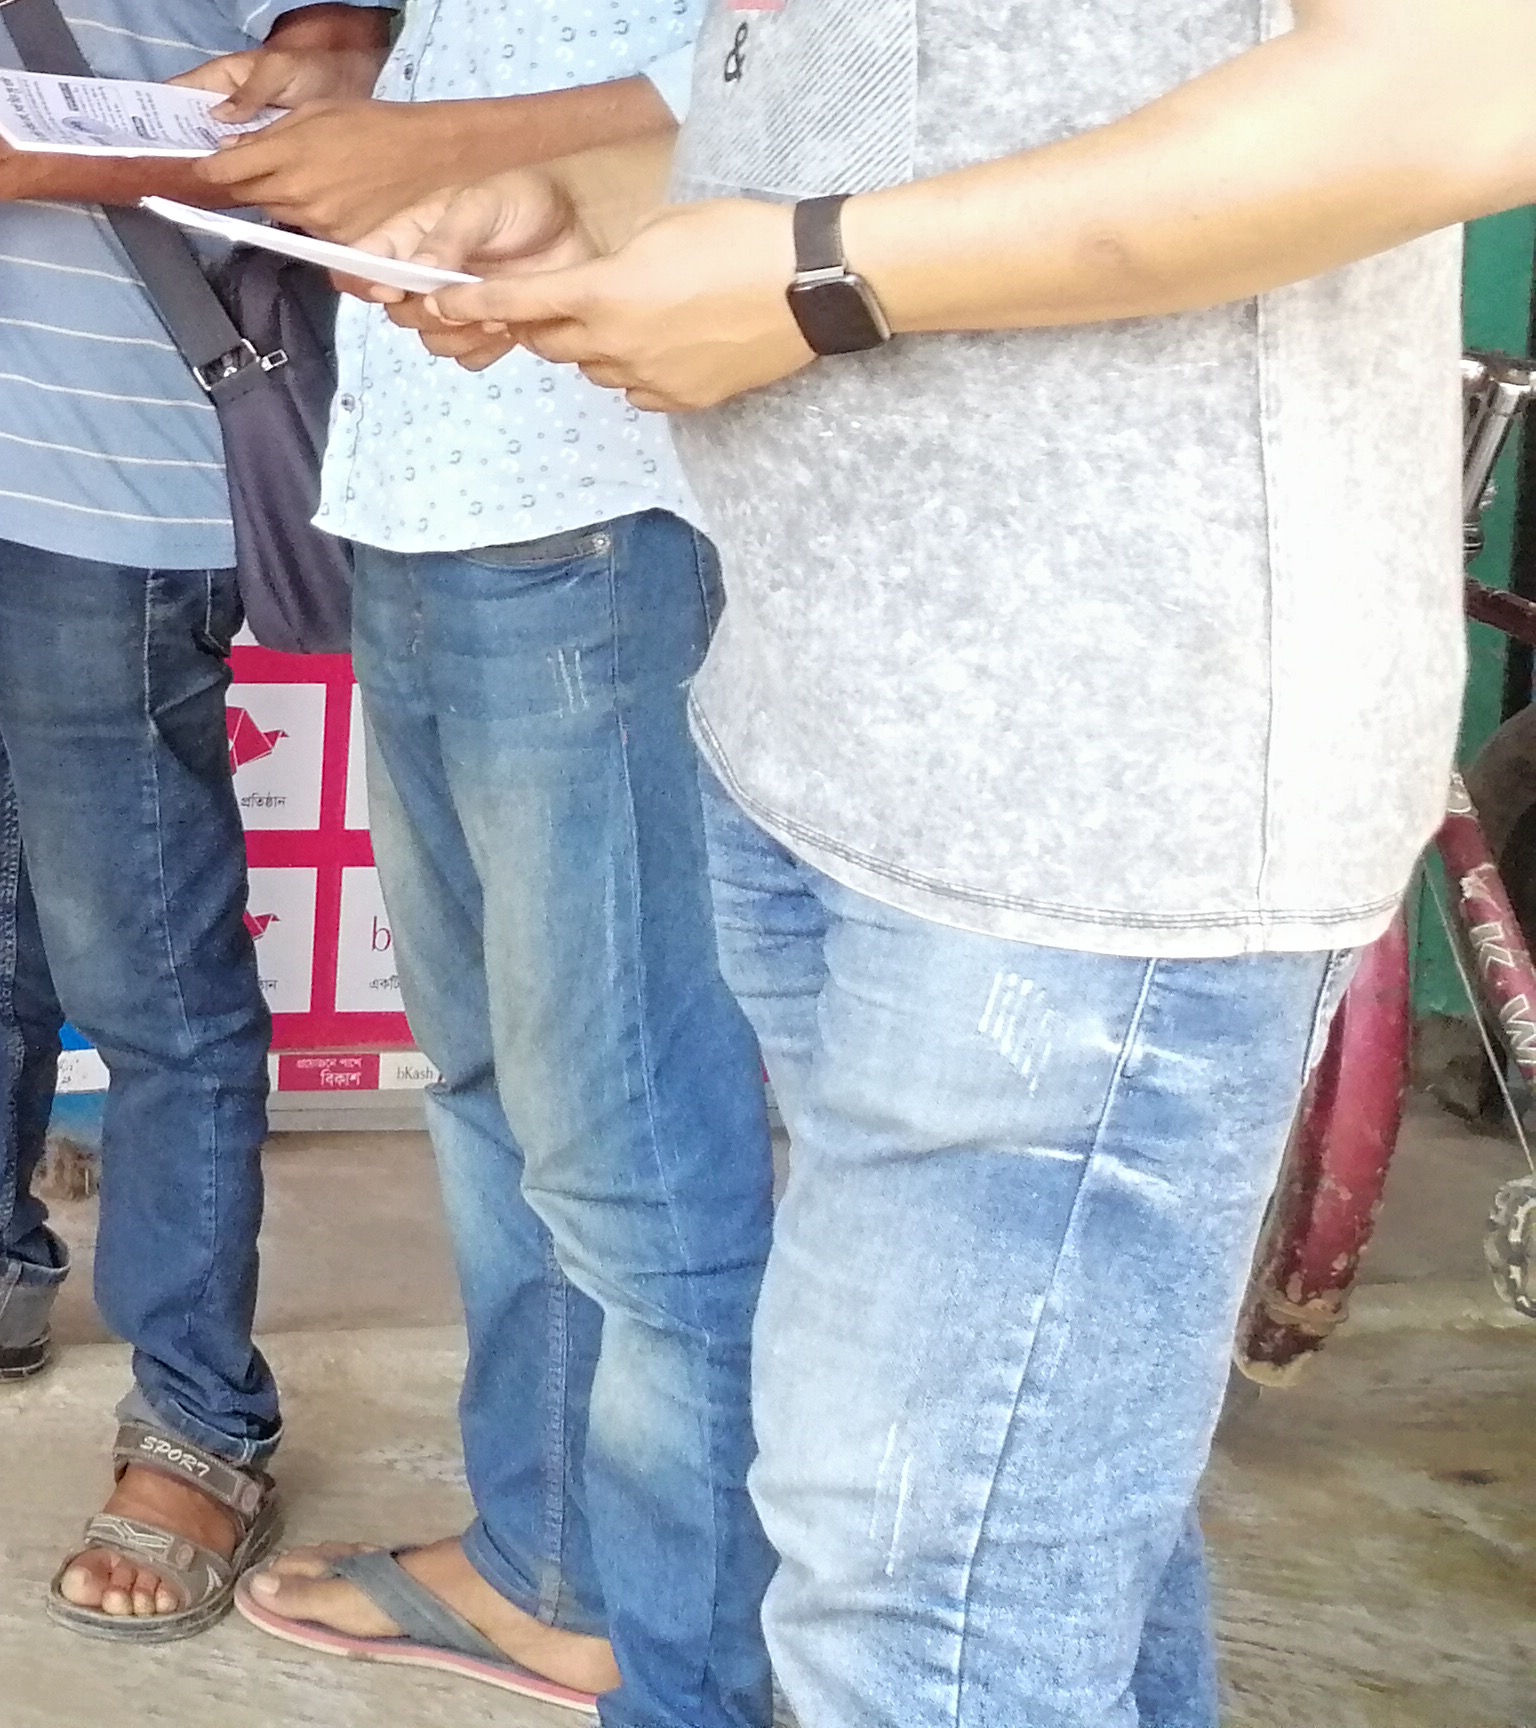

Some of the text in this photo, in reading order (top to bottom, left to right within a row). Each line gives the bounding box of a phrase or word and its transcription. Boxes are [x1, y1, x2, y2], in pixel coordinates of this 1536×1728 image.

[240, 792, 287, 809] প্রতিষ্ঠান
[320, 1068, 362, 1087] বিকাশ
[396, 1066, 434, 1081] bKash
[139, 1435, 211, 1478] SPORT
